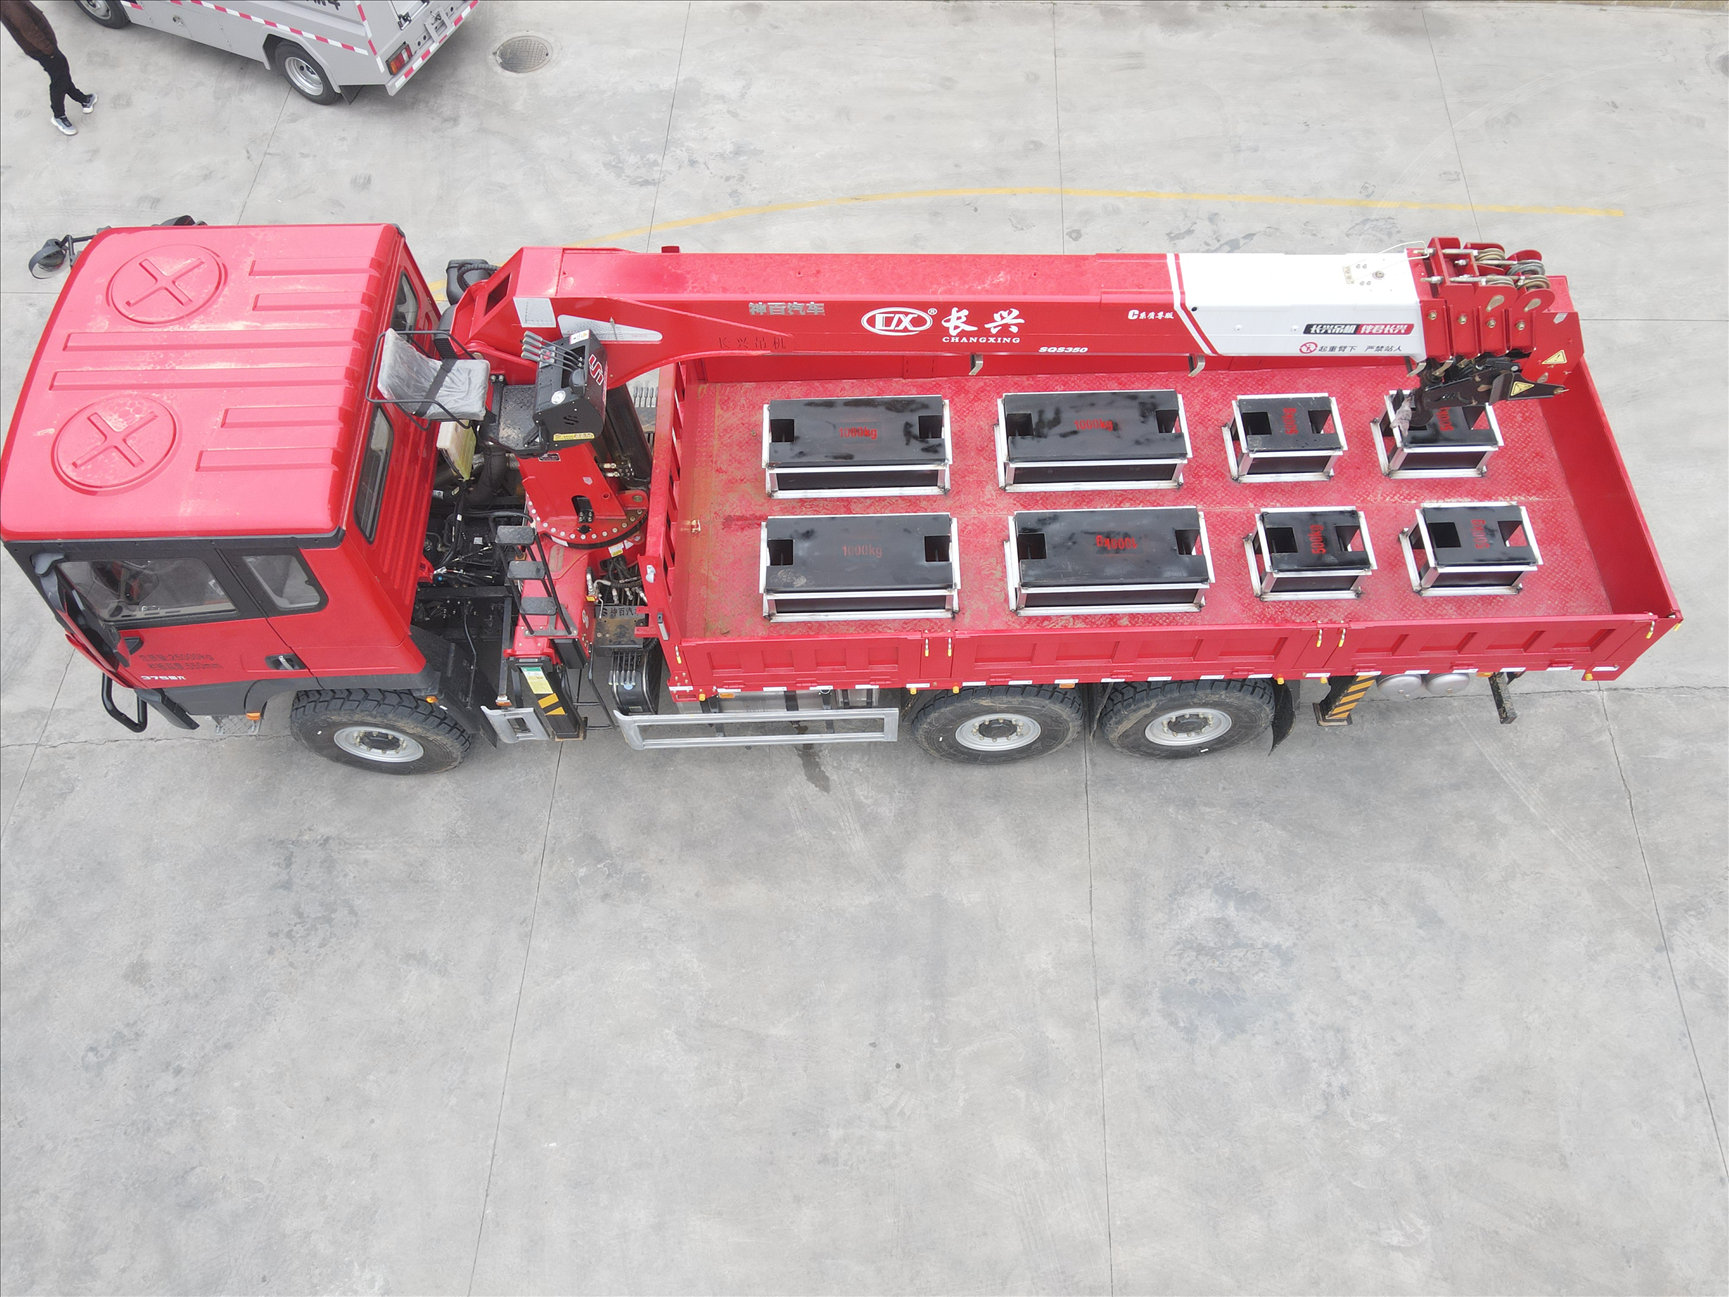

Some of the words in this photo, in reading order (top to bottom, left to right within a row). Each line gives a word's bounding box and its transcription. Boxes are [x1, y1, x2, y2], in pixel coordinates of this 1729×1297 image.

[748, 301, 825, 315] 神百汽车
[941, 307, 1025, 336] 长兴
[1310, 324, 1357, 334] 长兴吊机
[942, 336, 1021, 344] CHANGXING
[1073, 418, 1114, 432] 1000kg
[838, 425, 878, 440] 1000kg
[1307, 524, 1326, 554] 500kg
[842, 544, 883, 558] 1000kg
[610, 606, 637, 616] 神百汽
